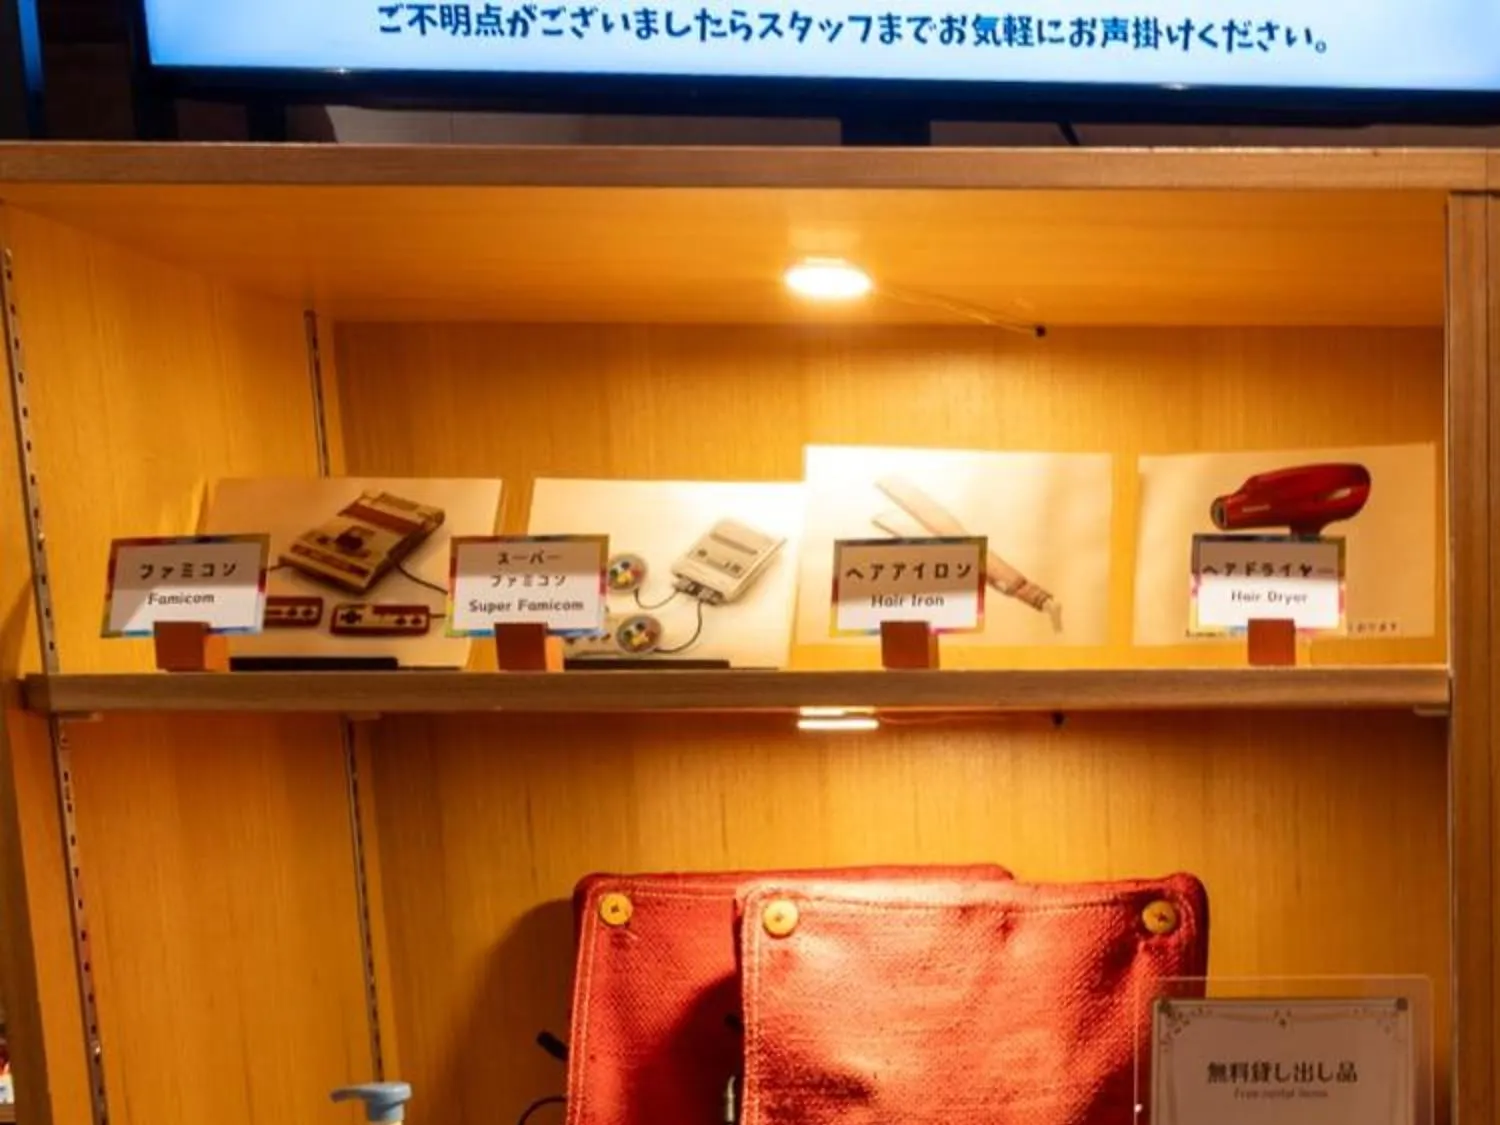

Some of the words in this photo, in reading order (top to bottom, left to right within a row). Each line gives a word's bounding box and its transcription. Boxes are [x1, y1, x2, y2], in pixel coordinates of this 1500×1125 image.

[378, 3, 1328, 54] ご不明点がございましたらスタッフまでお気軽にお声掛けください。
[497, 550, 562, 566] スーパー
[138, 561, 237, 580] ファミコン
[845, 562, 972, 581] ヘアアイロン
[490, 574, 566, 588] ファミコン
[147, 591, 215, 606] Famicom
[870, 593, 904, 608] Hair
[911, 592, 945, 607] Iron
[1230, 589, 1261, 602] Hair
[1267, 589, 1308, 605] Dryer
[468, 599, 511, 615] Super
[517, 598, 584, 612] Famicom
[1207, 1060, 1358, 1084] 無料貸し出し品
